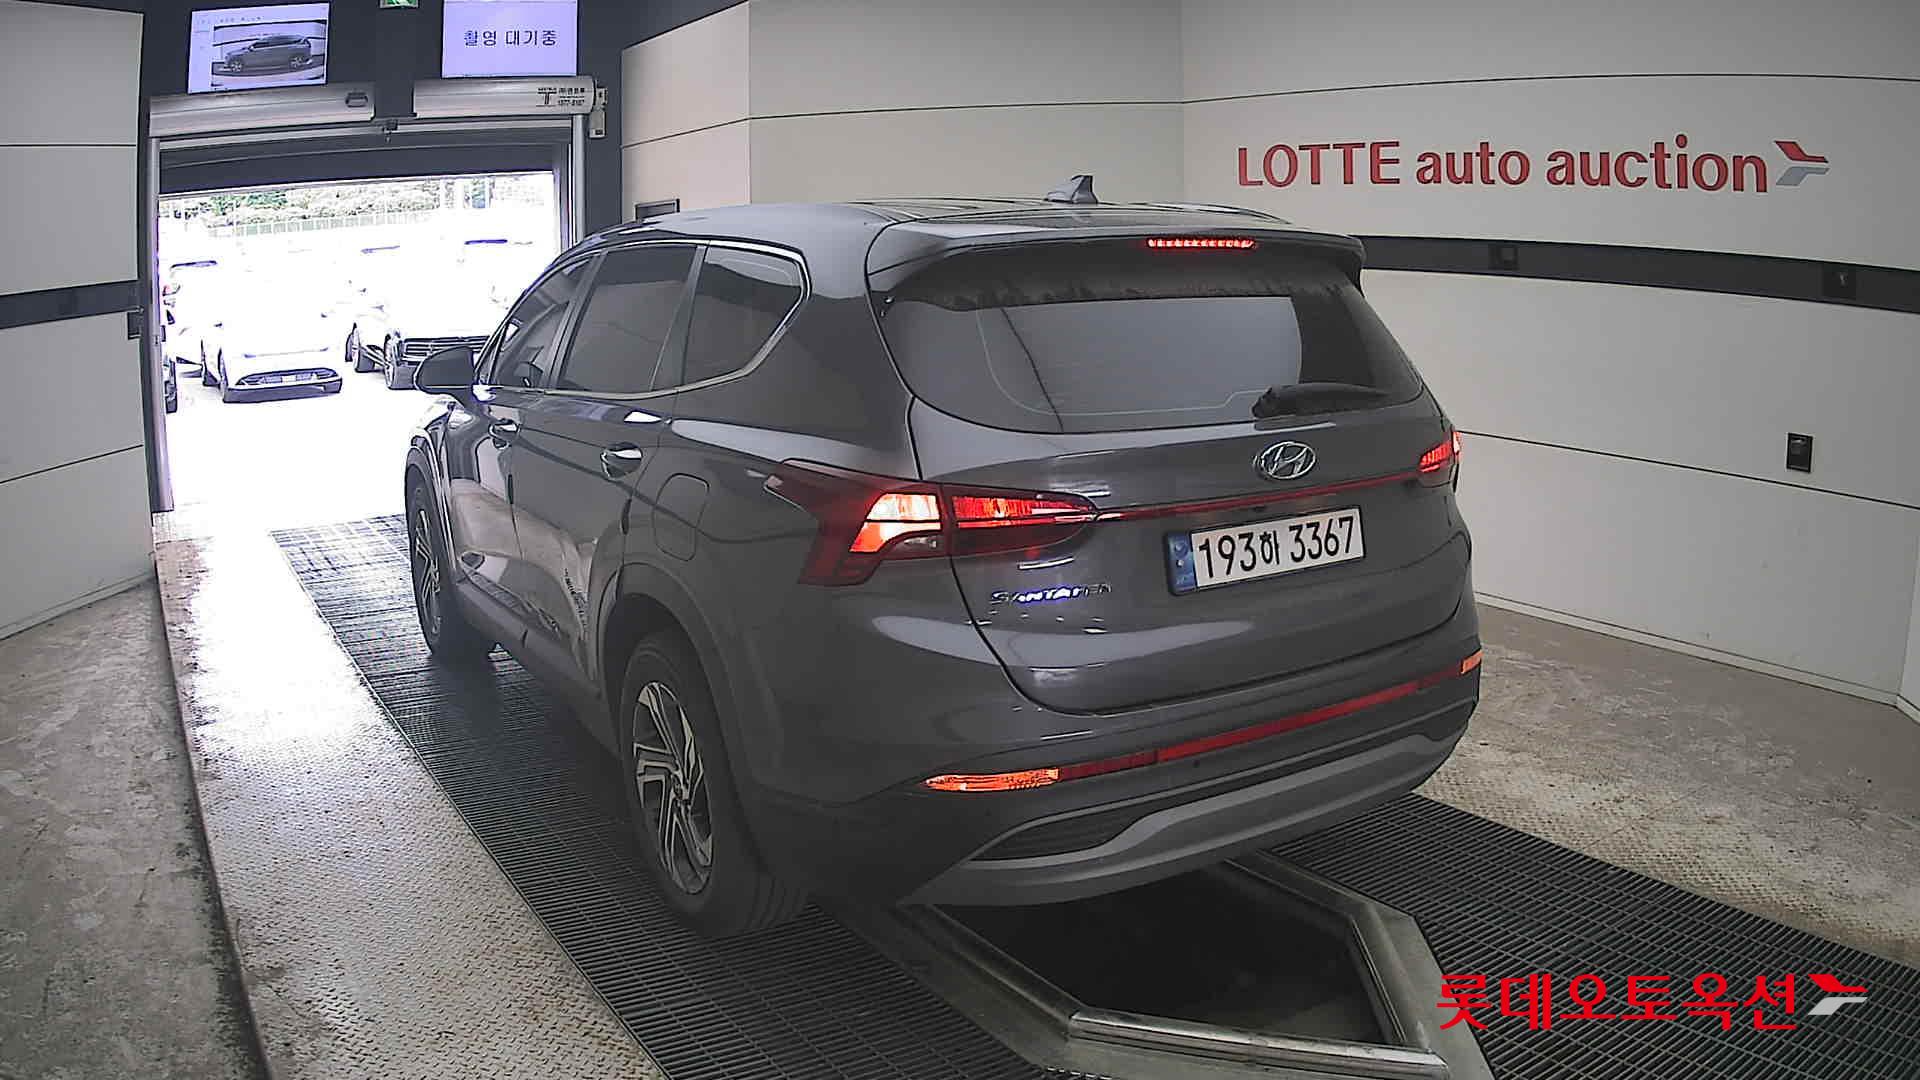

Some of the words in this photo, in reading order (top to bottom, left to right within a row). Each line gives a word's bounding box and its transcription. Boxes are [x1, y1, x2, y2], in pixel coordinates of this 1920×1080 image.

[505, 30, 557, 46] 대기중
[1239, 142, 1400, 187] LOTTE
[1416, 142, 1531, 186] auto
[1545, 134, 1768, 193] auction
[1198, 532, 1280, 578] 193하
[1288, 516, 1354, 563] 3367
